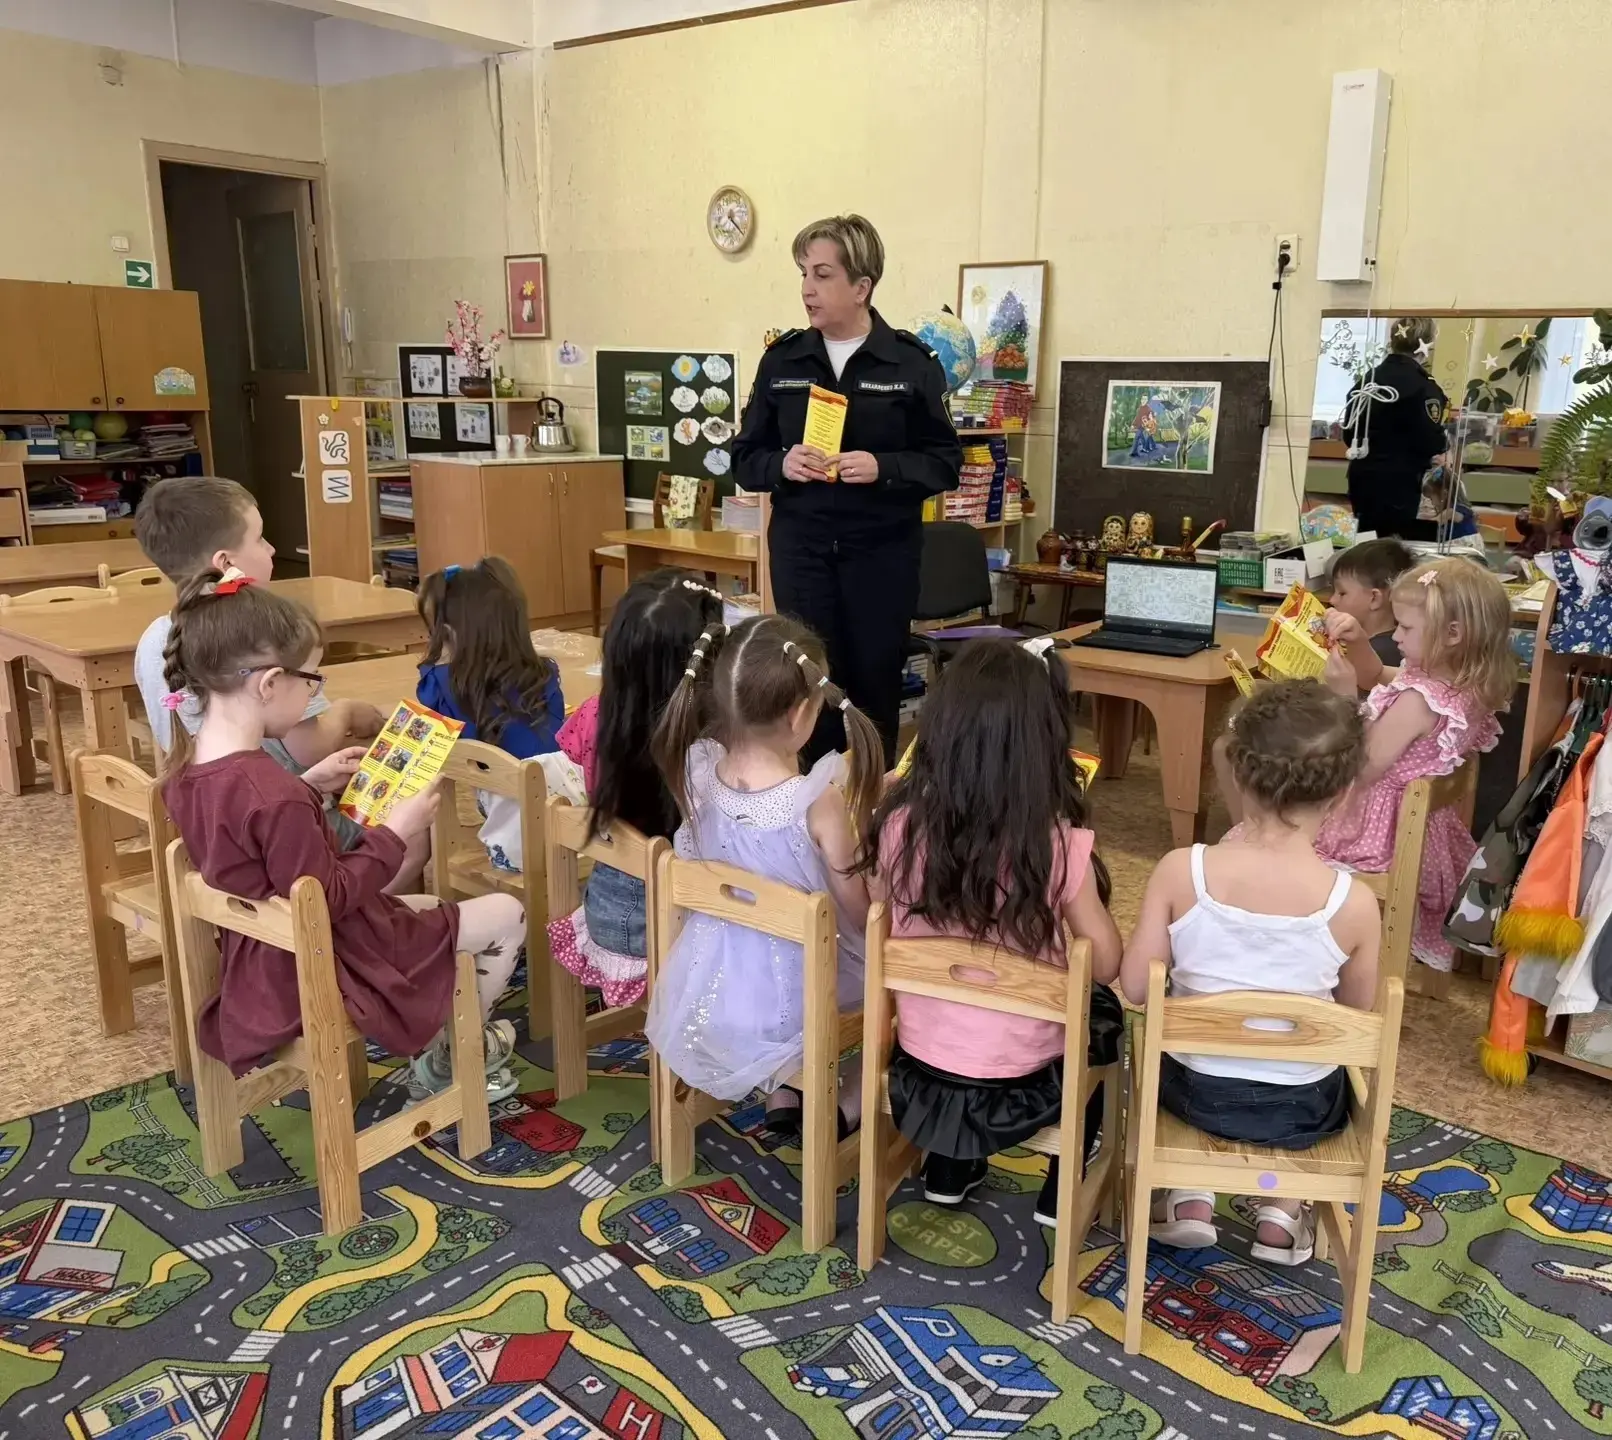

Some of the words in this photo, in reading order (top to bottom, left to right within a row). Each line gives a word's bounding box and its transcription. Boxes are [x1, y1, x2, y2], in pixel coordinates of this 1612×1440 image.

[891, 1212, 983, 1265] CARPET
[920, 1208, 982, 1241] BEST
[902, 1316, 957, 1338] P
[618, 1400, 654, 1440] H
[894, 1387, 944, 1440] POLICE
